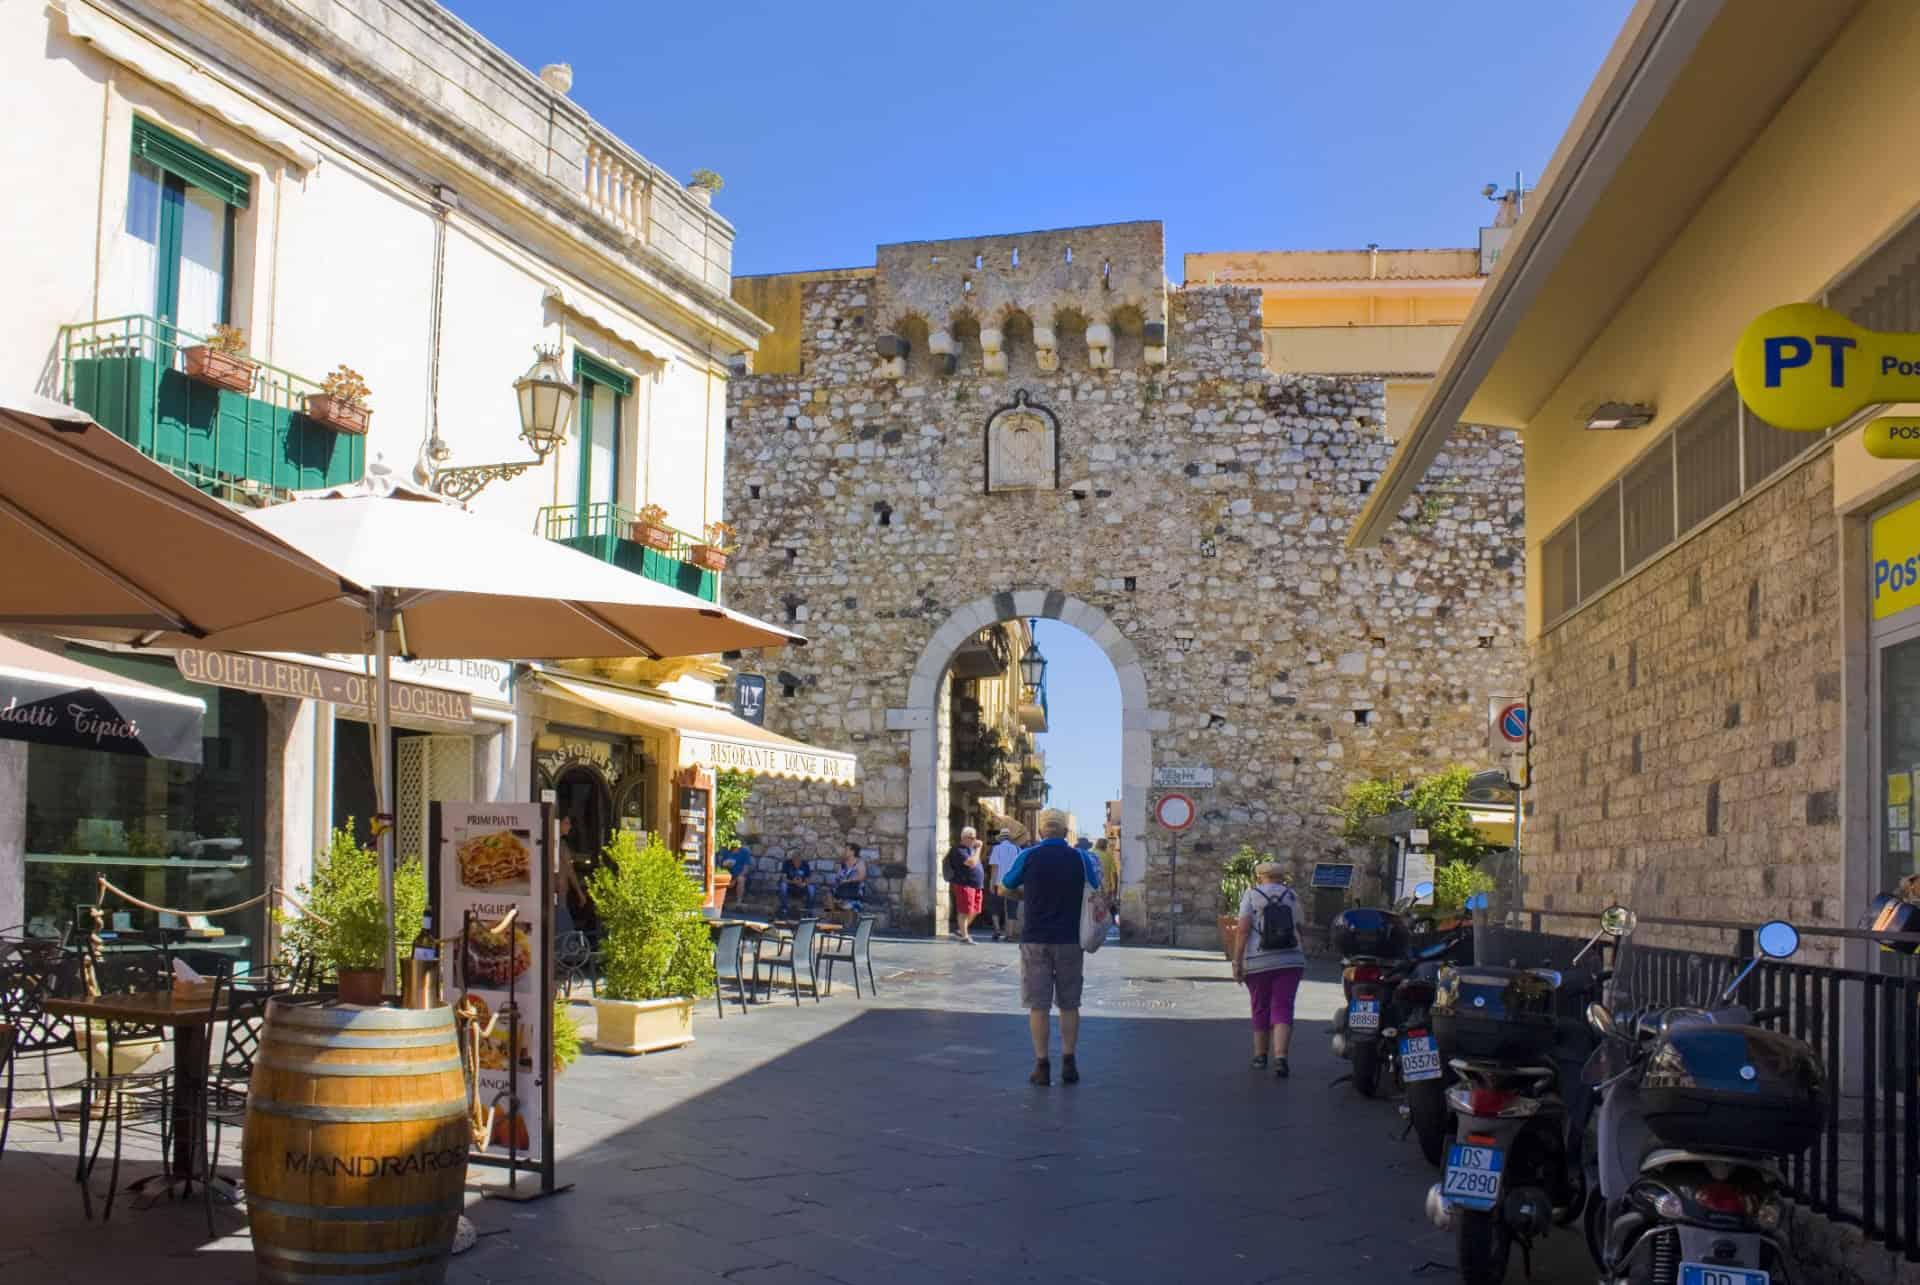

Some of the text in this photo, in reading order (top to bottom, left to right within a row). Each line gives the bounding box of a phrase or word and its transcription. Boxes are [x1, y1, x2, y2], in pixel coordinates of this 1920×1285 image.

[1764, 335, 1857, 388] PT
[181, 649, 324, 698] GIOIELLERIA
[346, 677, 466, 719] OLOGERIA
[67, 704, 142, 744] Tipici
[710, 743, 775, 769] RISTORANTE
[492, 815, 519, 826] PIATTI
[1462, 1148, 1483, 1168] DS
[1447, 1170, 1498, 1194] 72890
